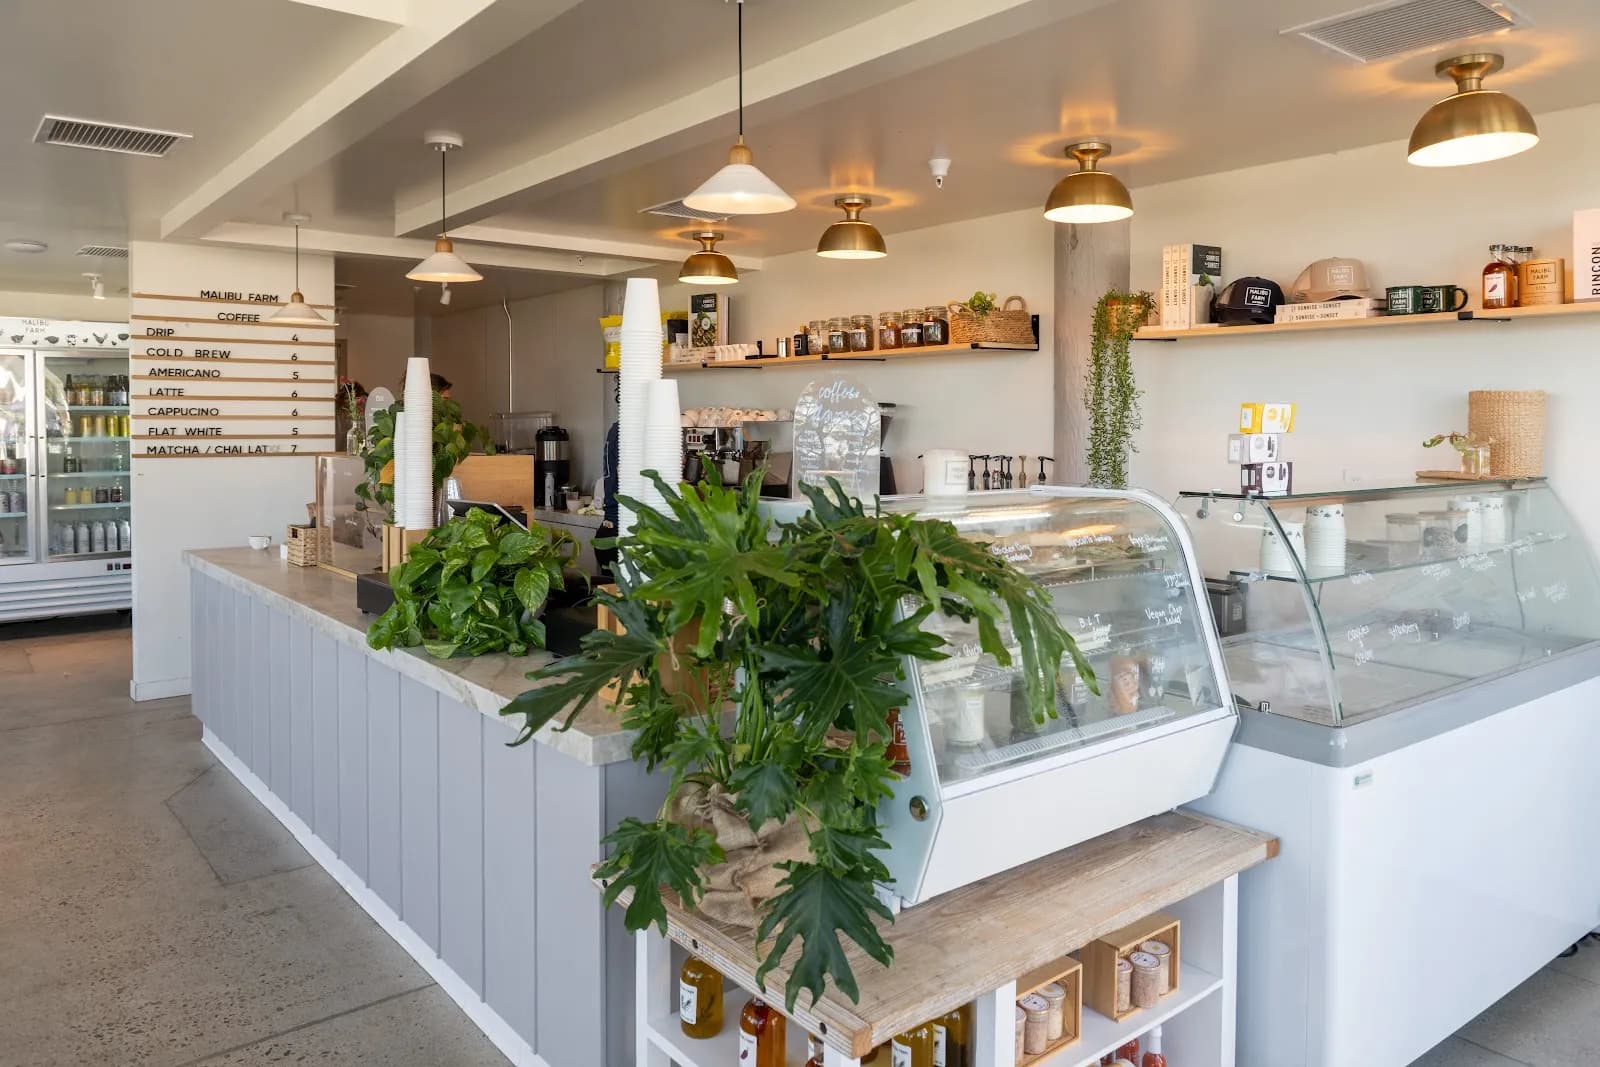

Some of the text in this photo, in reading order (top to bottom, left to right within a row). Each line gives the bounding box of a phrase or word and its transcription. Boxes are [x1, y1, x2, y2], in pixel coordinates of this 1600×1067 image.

[200, 289, 279, 303] MALIBU FARM
[1249, 288, 1269, 296] MALIBU
[217, 312, 260, 323] COFFEE
[146, 327, 299, 343] DRIP 4
[146, 347, 298, 361] COLD BREW 6
[148, 367, 299, 380] AMERICANO 5
[149, 387, 298, 399] LATTE 6
[147, 407, 298, 417] CAPPUCINO 6
[148, 427, 298, 437] FLAT WHITE 5
[146, 444, 298, 455] MATCHA / CHAI LAT 7
